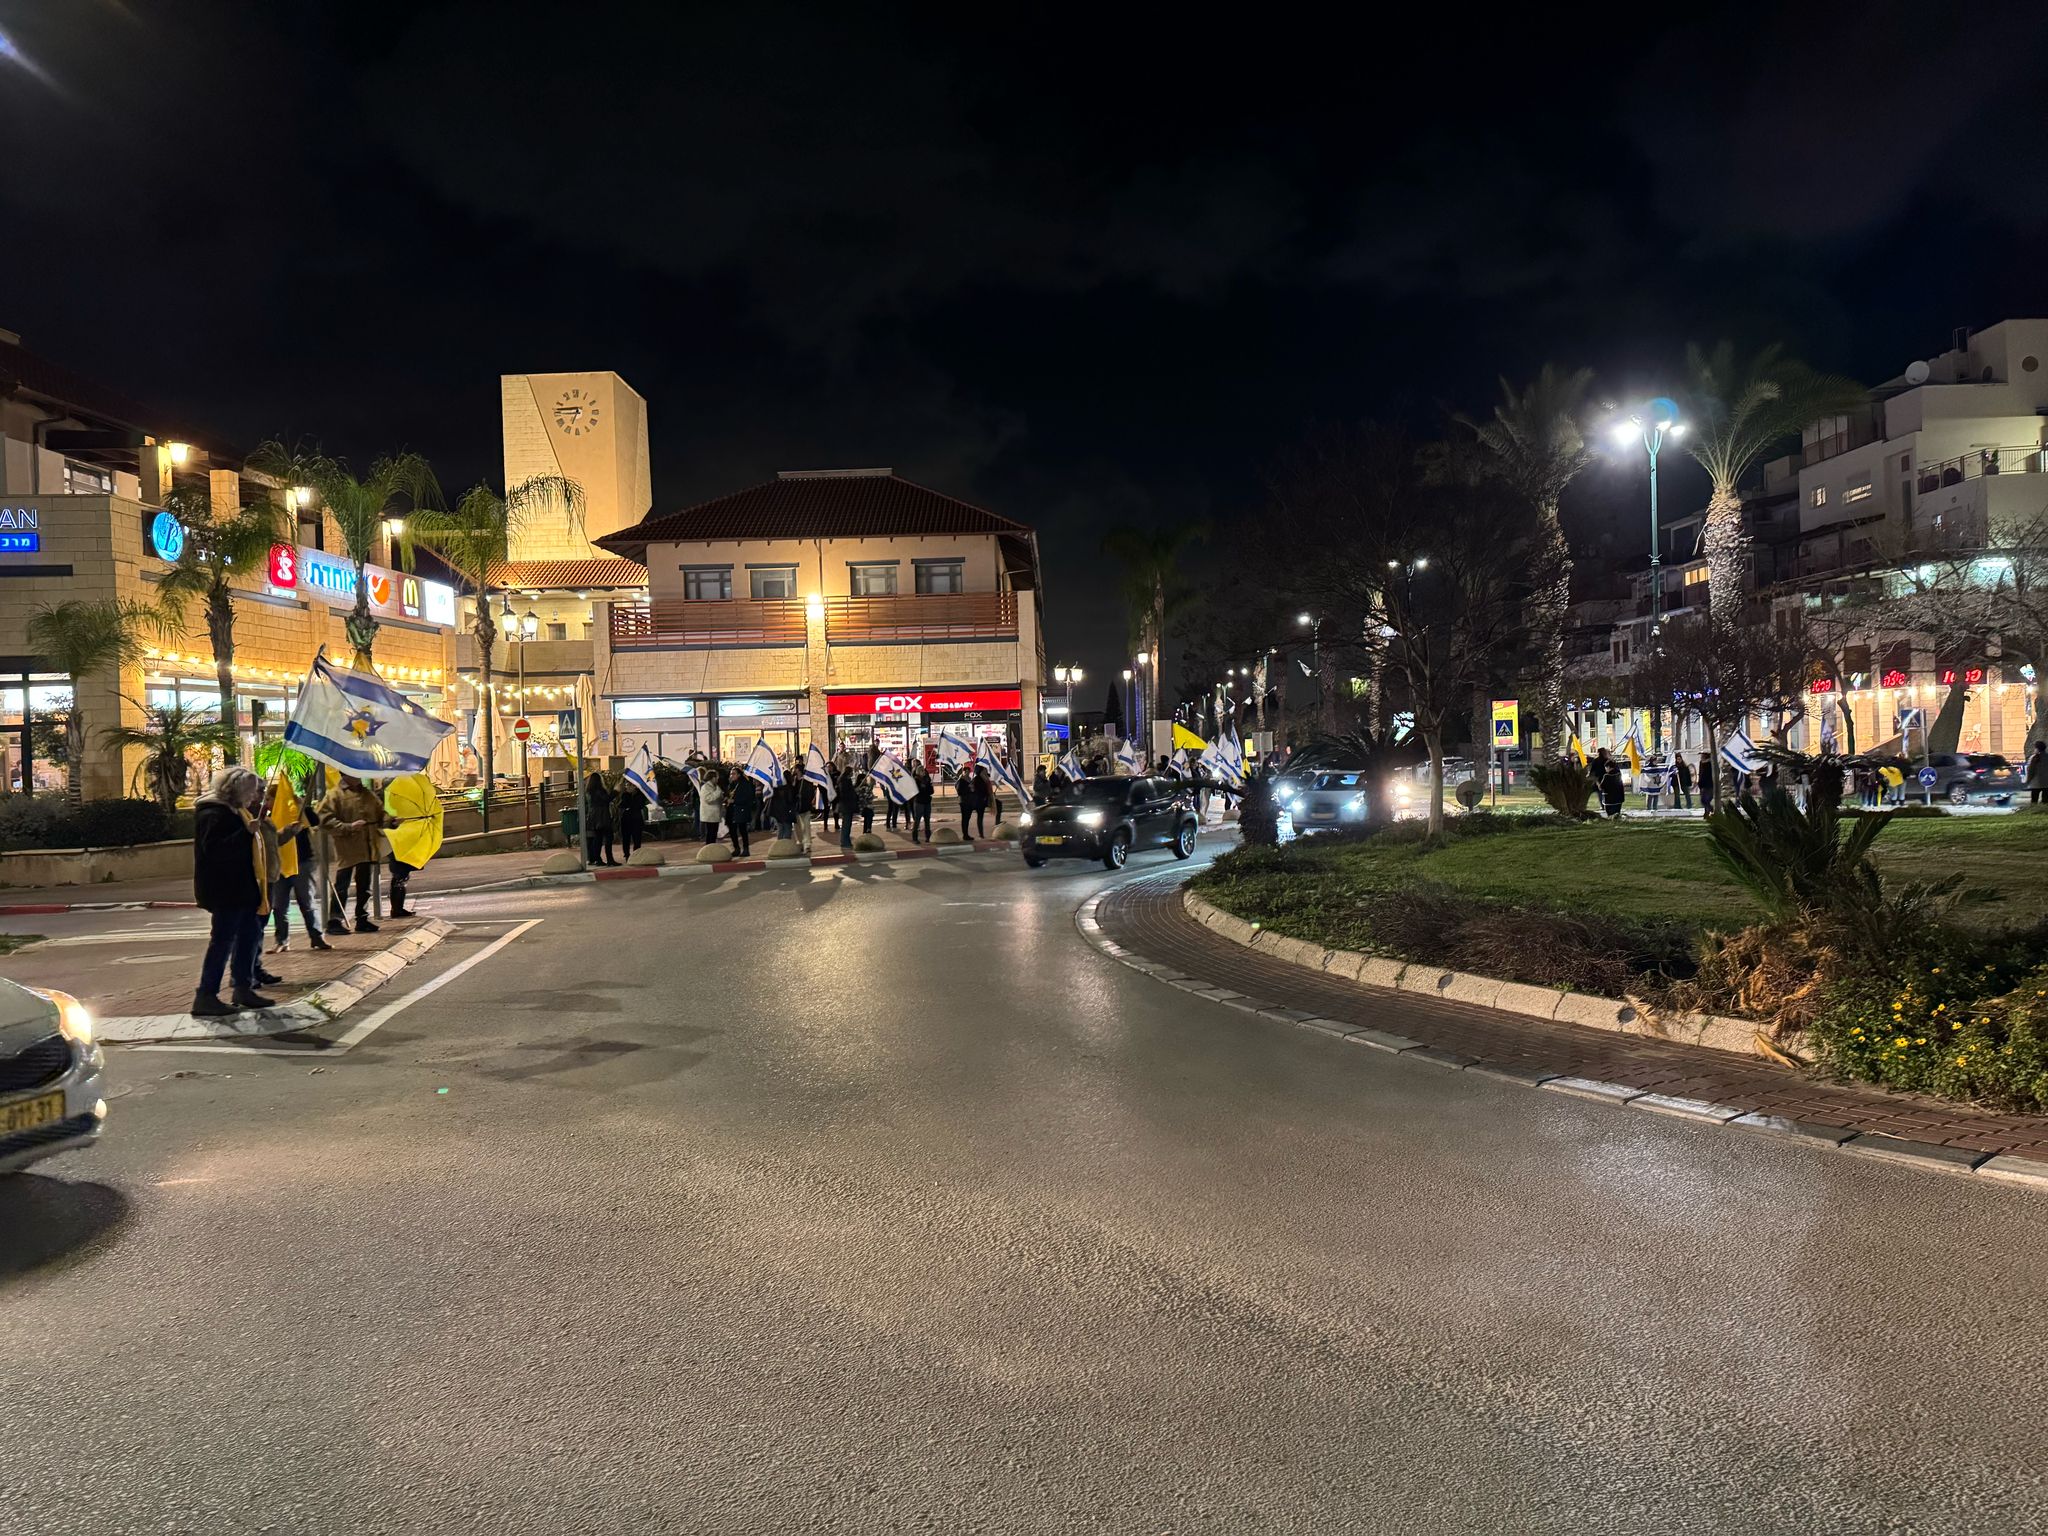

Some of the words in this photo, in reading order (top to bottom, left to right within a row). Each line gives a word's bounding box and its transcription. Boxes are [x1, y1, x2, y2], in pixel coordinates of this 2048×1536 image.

[0, 508, 38, 529] AN
[309, 561, 369, 594] אוחדת
[875, 695, 923, 711] FOX
